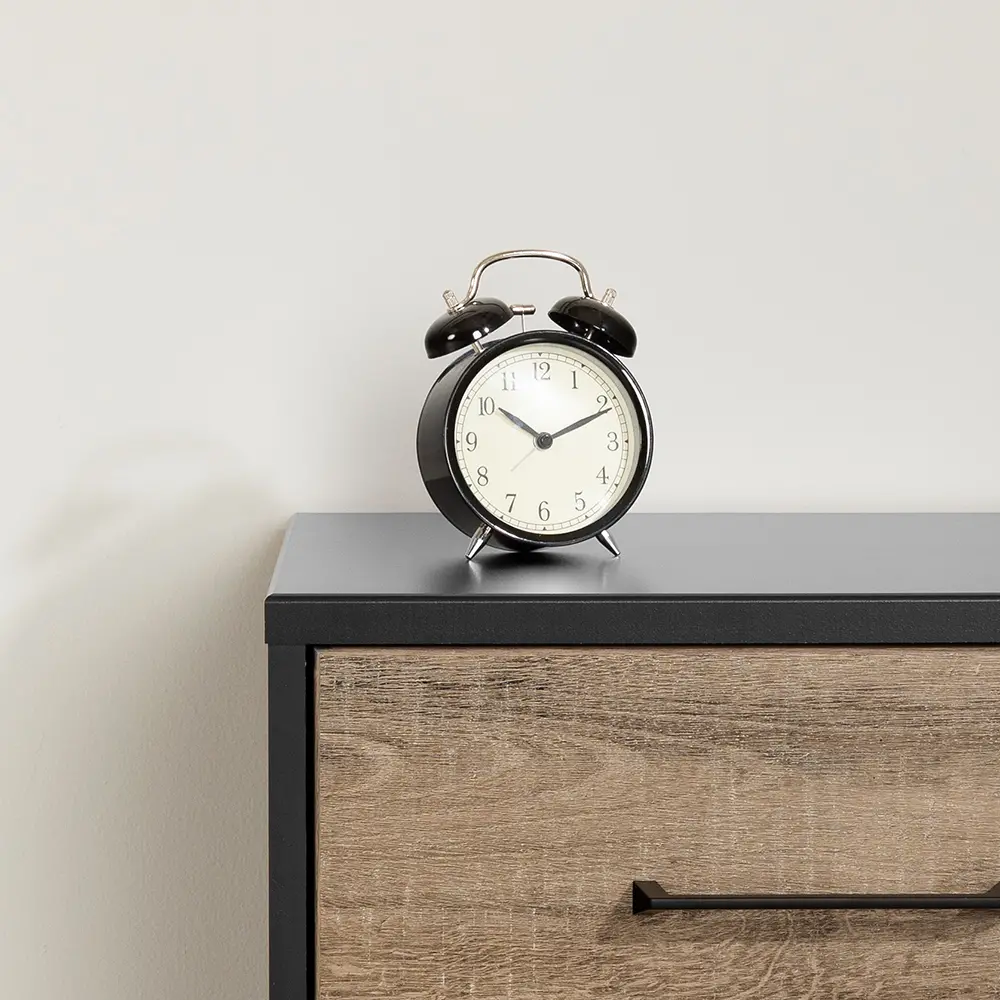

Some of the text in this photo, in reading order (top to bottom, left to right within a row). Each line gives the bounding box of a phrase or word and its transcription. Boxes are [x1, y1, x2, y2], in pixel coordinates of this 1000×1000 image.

[532, 362, 550, 380] 12
[571, 370, 578, 389] 1
[502, 372, 516, 391] 11
[478, 396, 495, 416] 10
[596, 395, 609, 413] 2
[466, 432, 478, 452] 9
[607, 432, 619, 451] 3
[477, 466, 489, 486] 8
[596, 466, 609, 484] 4
[505, 494, 516, 513] 7
[538, 501, 550, 521] 6
[574, 491, 586, 512] 5
